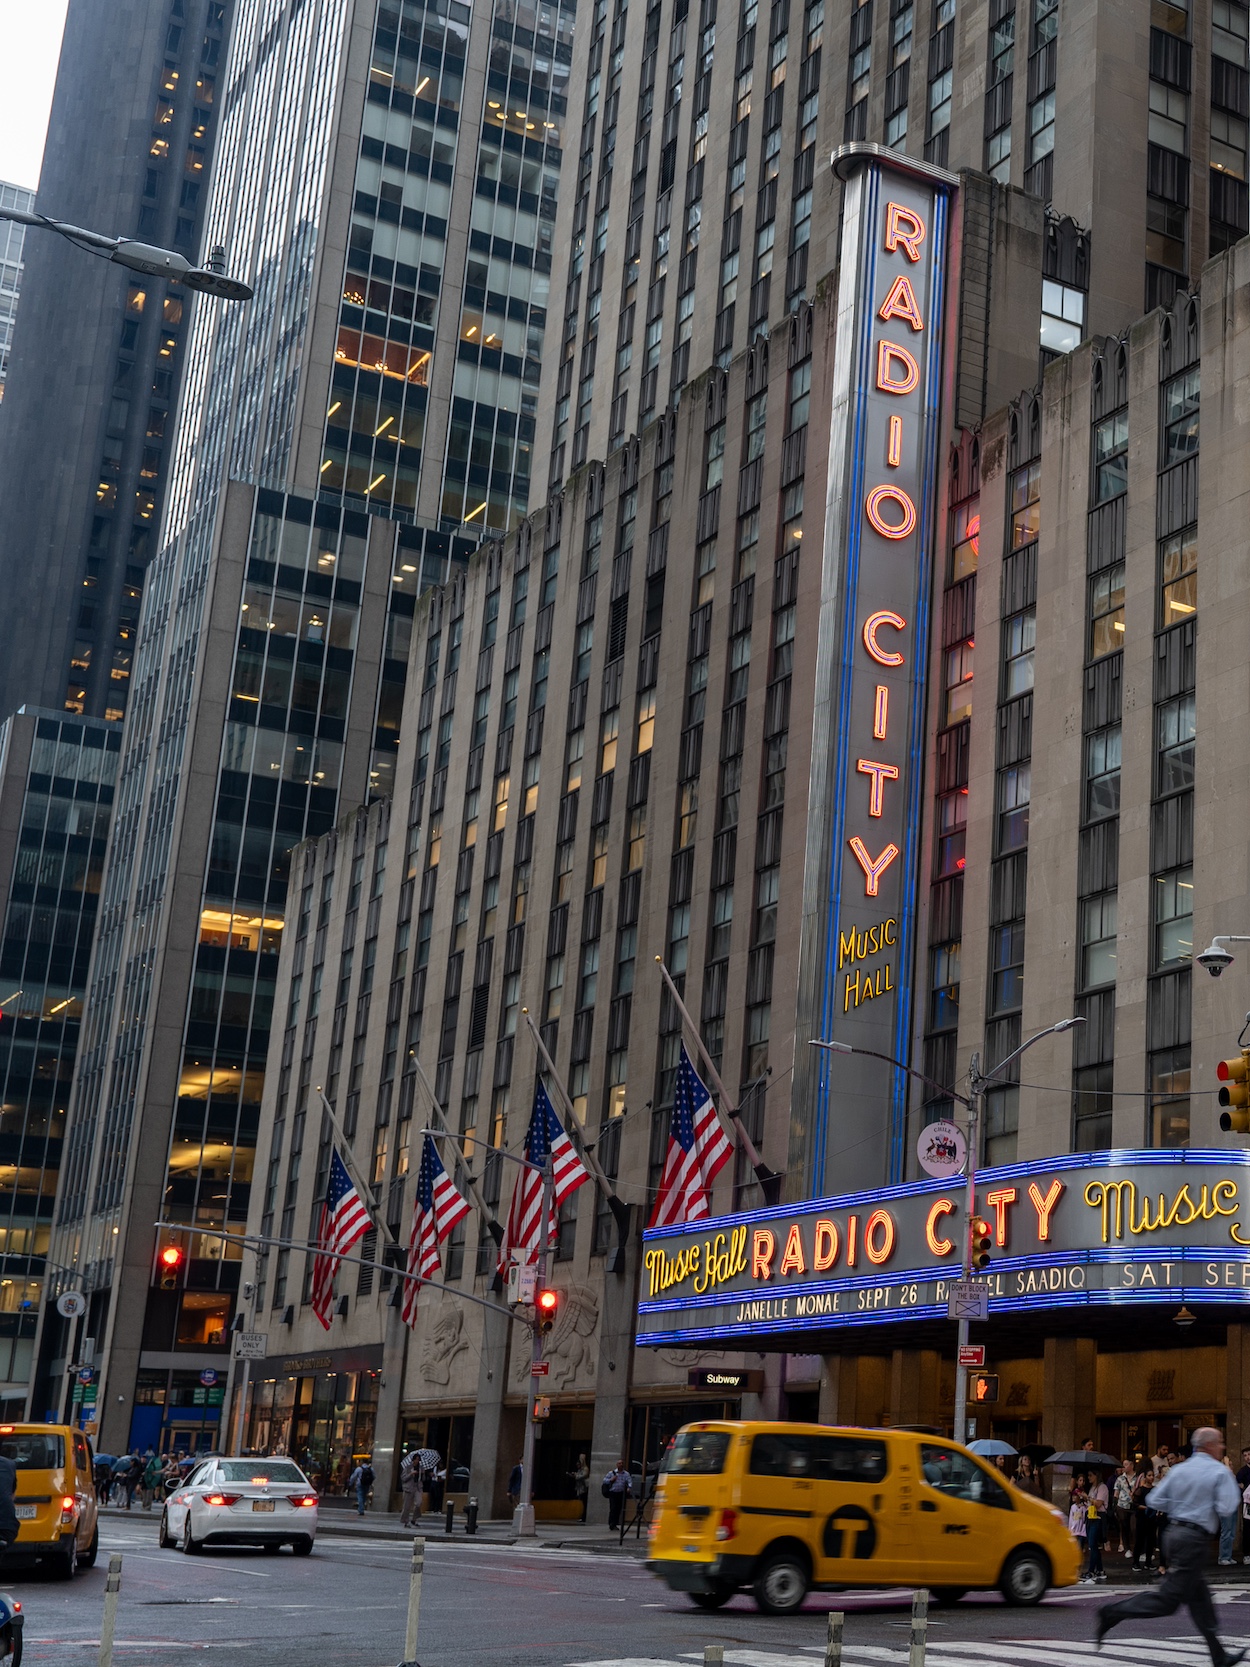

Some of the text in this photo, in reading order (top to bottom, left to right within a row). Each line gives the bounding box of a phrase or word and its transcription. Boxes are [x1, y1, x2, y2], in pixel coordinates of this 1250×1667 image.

[866, 201, 926, 541] RADIO
[848, 610, 906, 898] CITY
[934, 1127, 951, 1135] CHILE
[752, 1178, 1066, 1280] RADIO CTY
[1084, 1179, 1239, 1242] Music
[645, 1224, 748, 1297] Music Hall
[1016, 1266, 1086, 1293] SAADIQ
[736, 1298, 788, 1322] JANELLE
[796, 1292, 840, 1315] MONAE
[857, 1286, 893, 1310] SEPT
[900, 1283, 918, 1304] 26
[951, 1284, 986, 1292] DON'T BLOCK
[241, 1334, 262, 1342] BUSES
[706, 1373, 740, 1386] Subway
